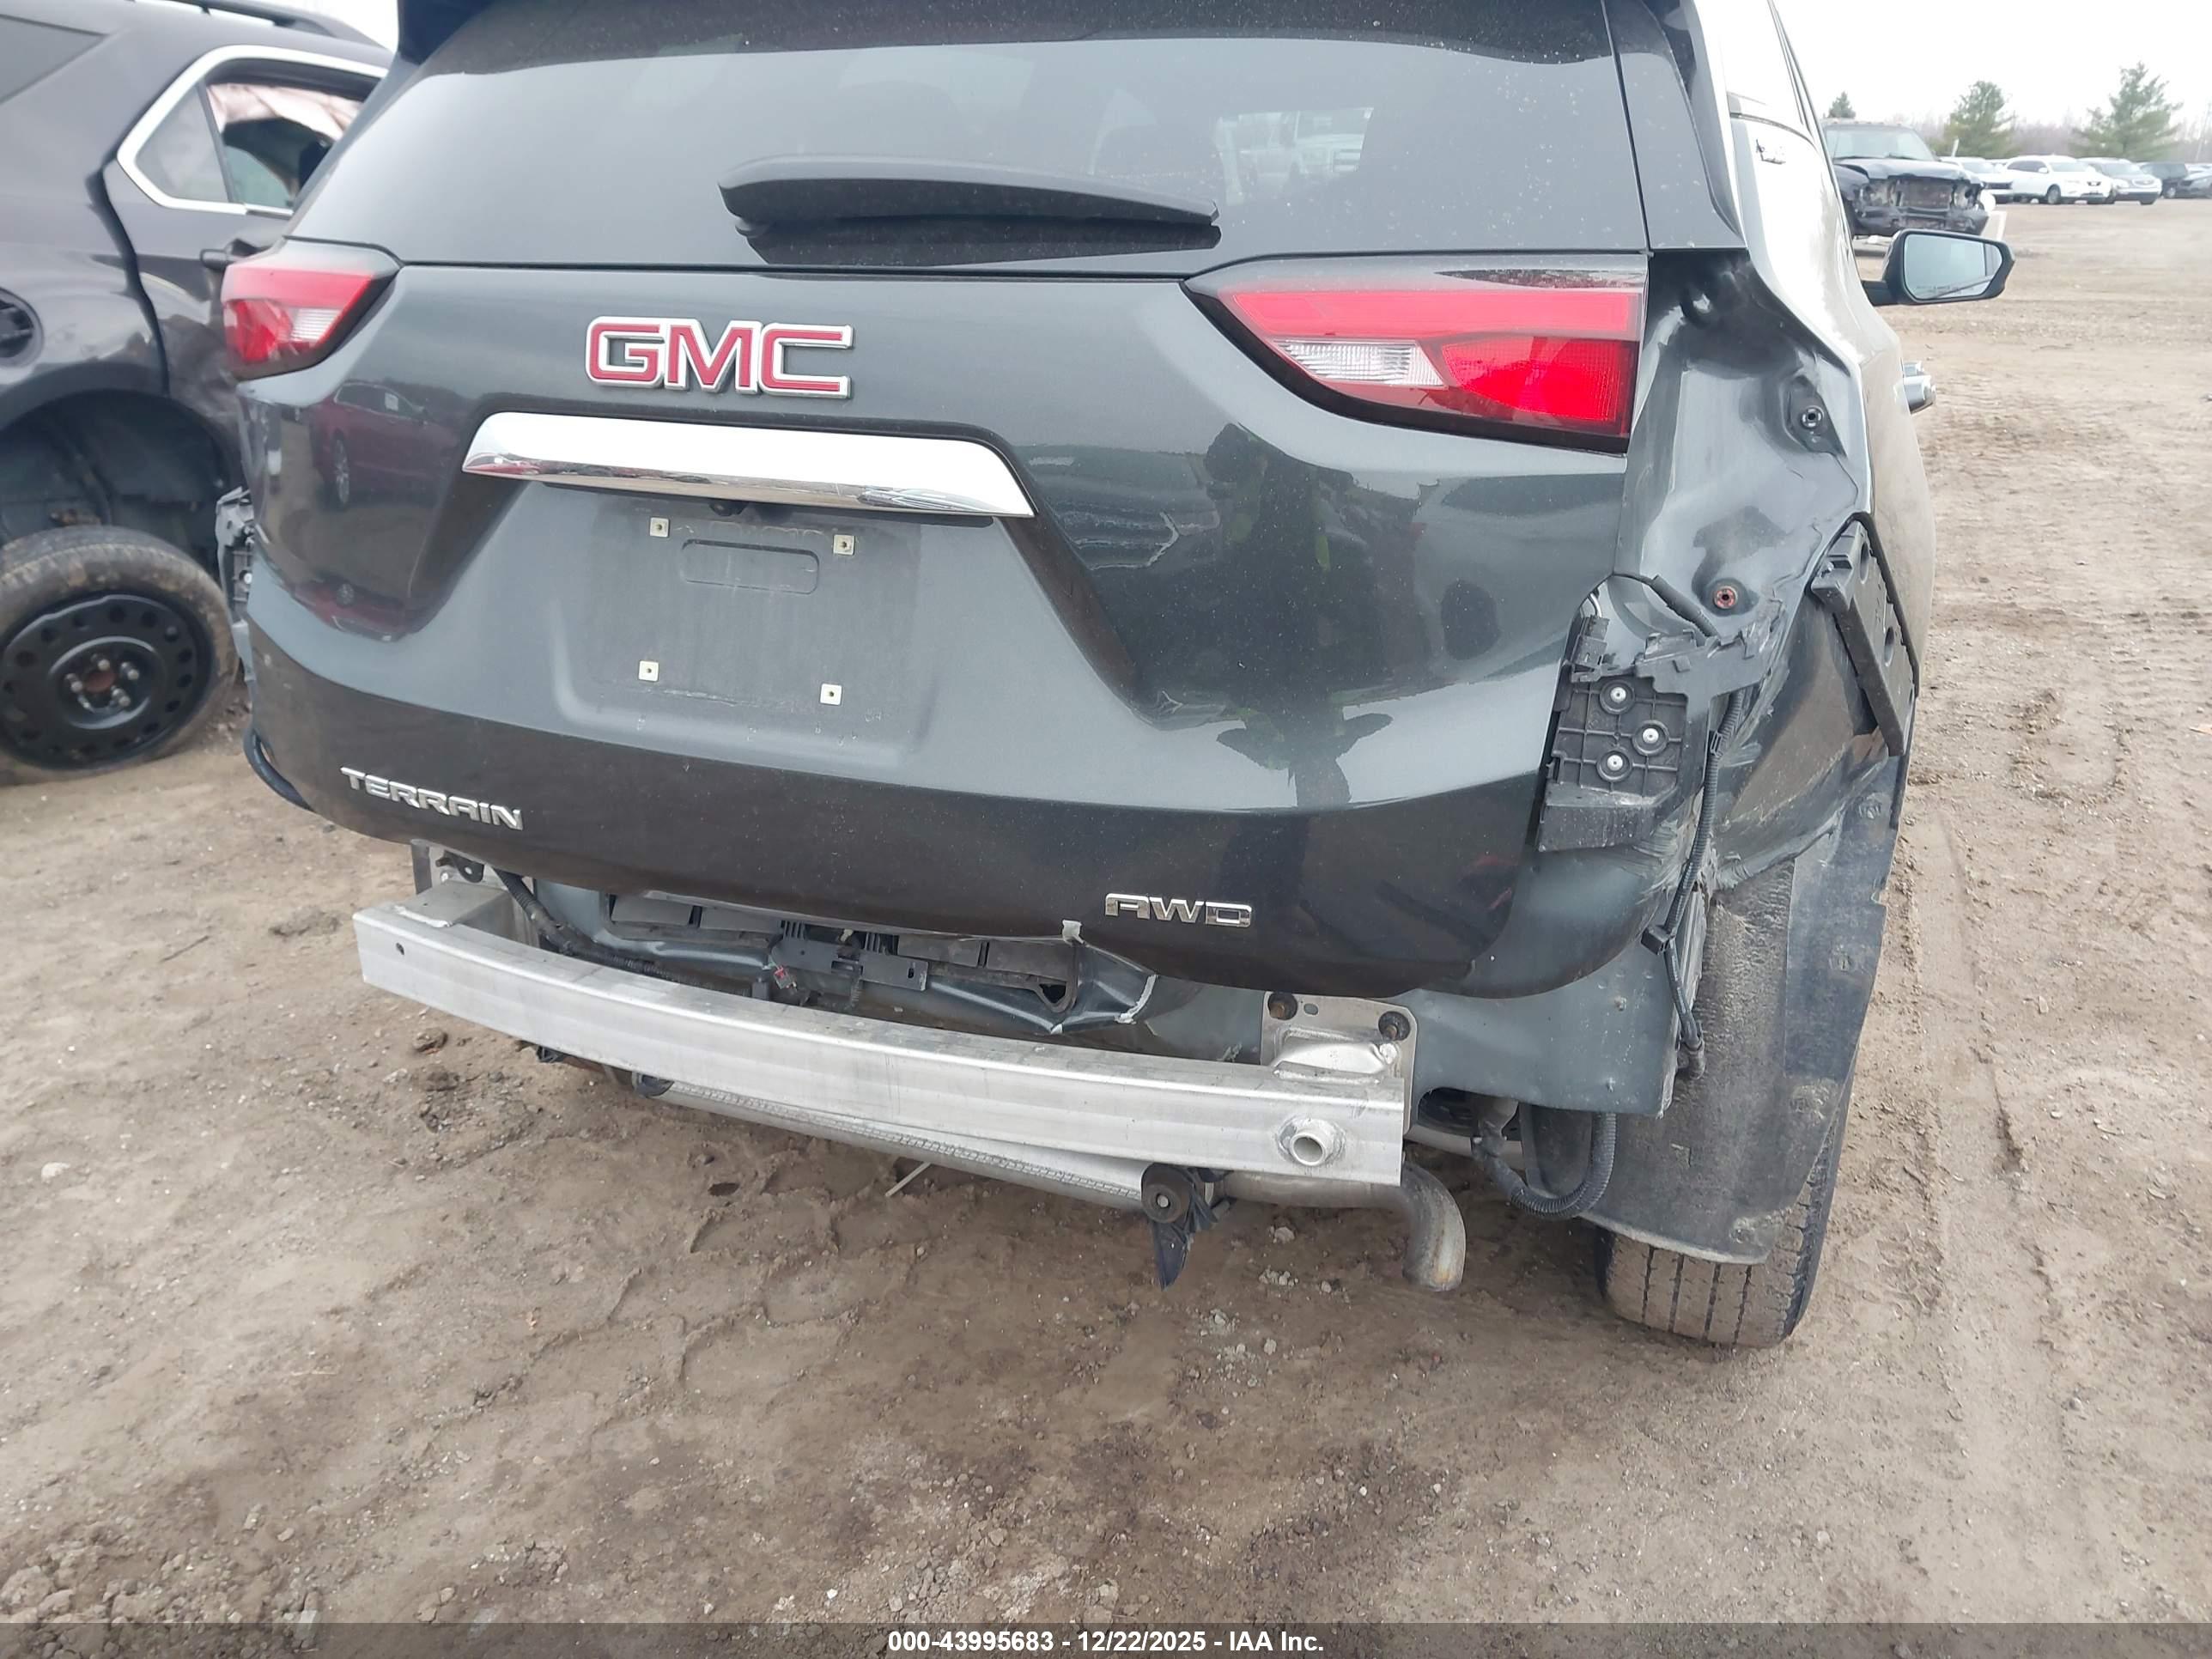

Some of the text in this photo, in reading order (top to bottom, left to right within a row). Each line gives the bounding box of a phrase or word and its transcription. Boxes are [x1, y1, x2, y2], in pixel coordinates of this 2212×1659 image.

[586, 316, 854, 398] GMC
[340, 766, 524, 830] TERRAIN
[1104, 892, 1252, 927] AWD
